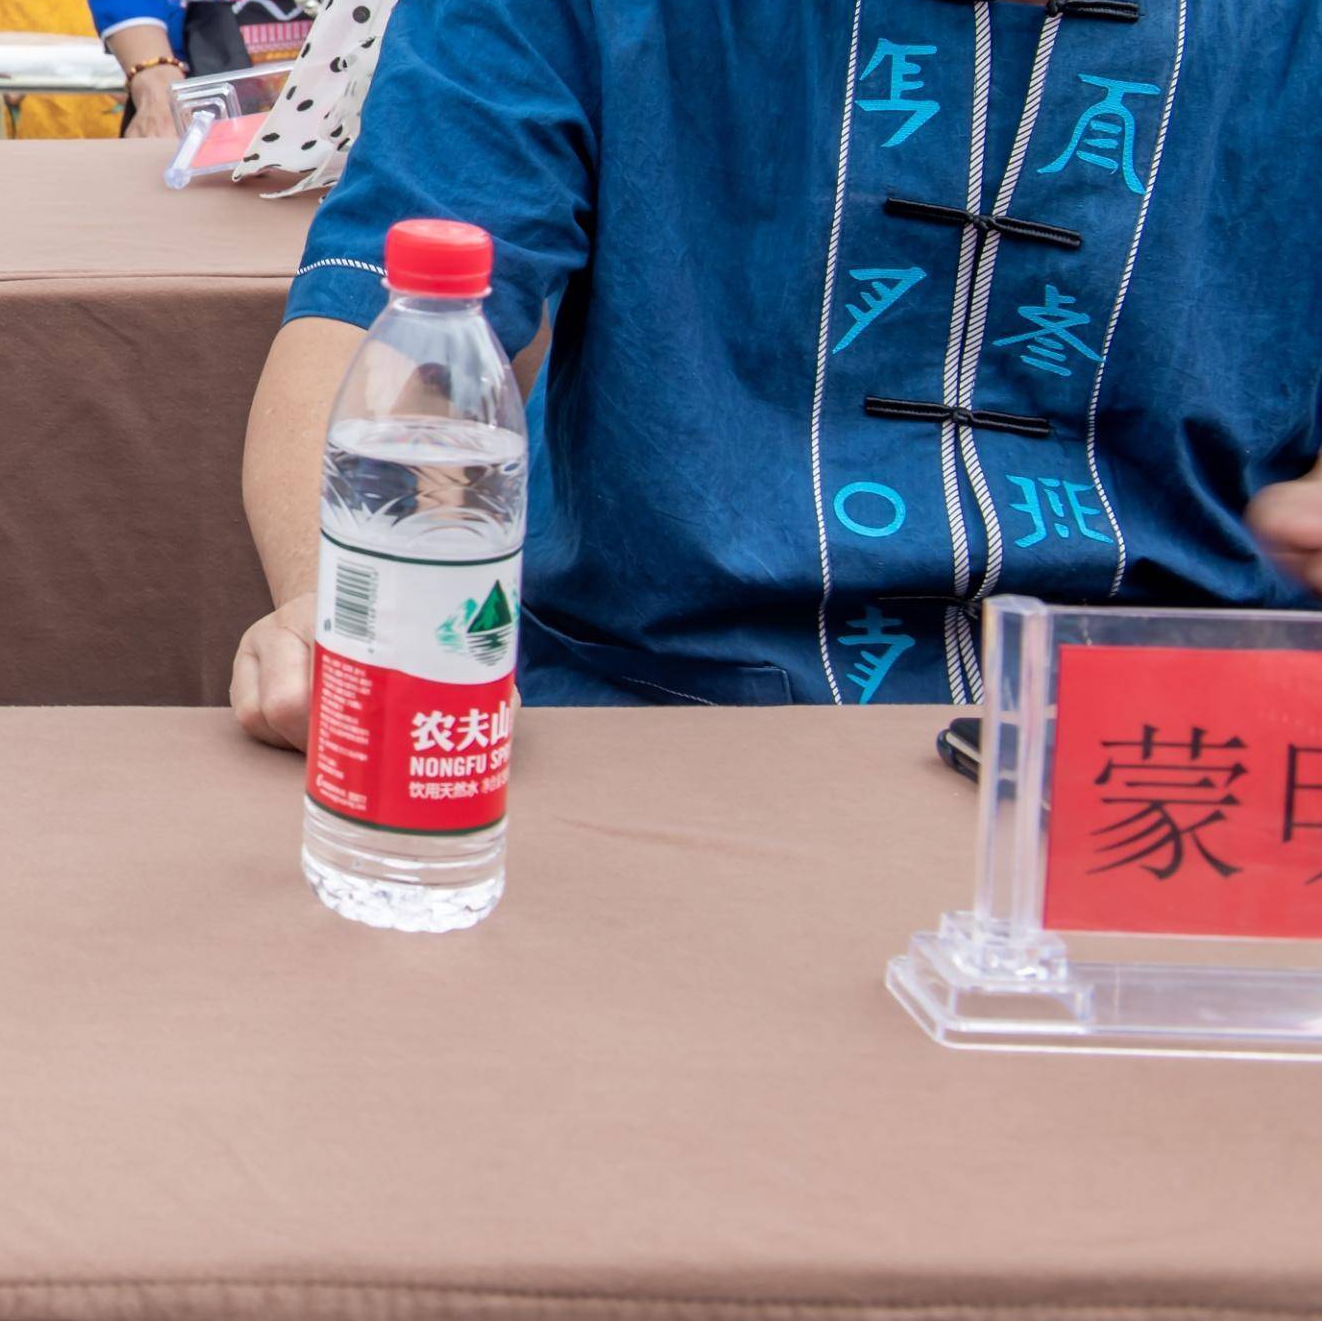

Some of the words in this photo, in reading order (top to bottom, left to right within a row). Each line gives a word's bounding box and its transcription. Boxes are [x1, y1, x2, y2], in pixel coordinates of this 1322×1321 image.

[409, 752, 488, 778] NONGFU
[408, 779, 480, 799] 饮用天然水
